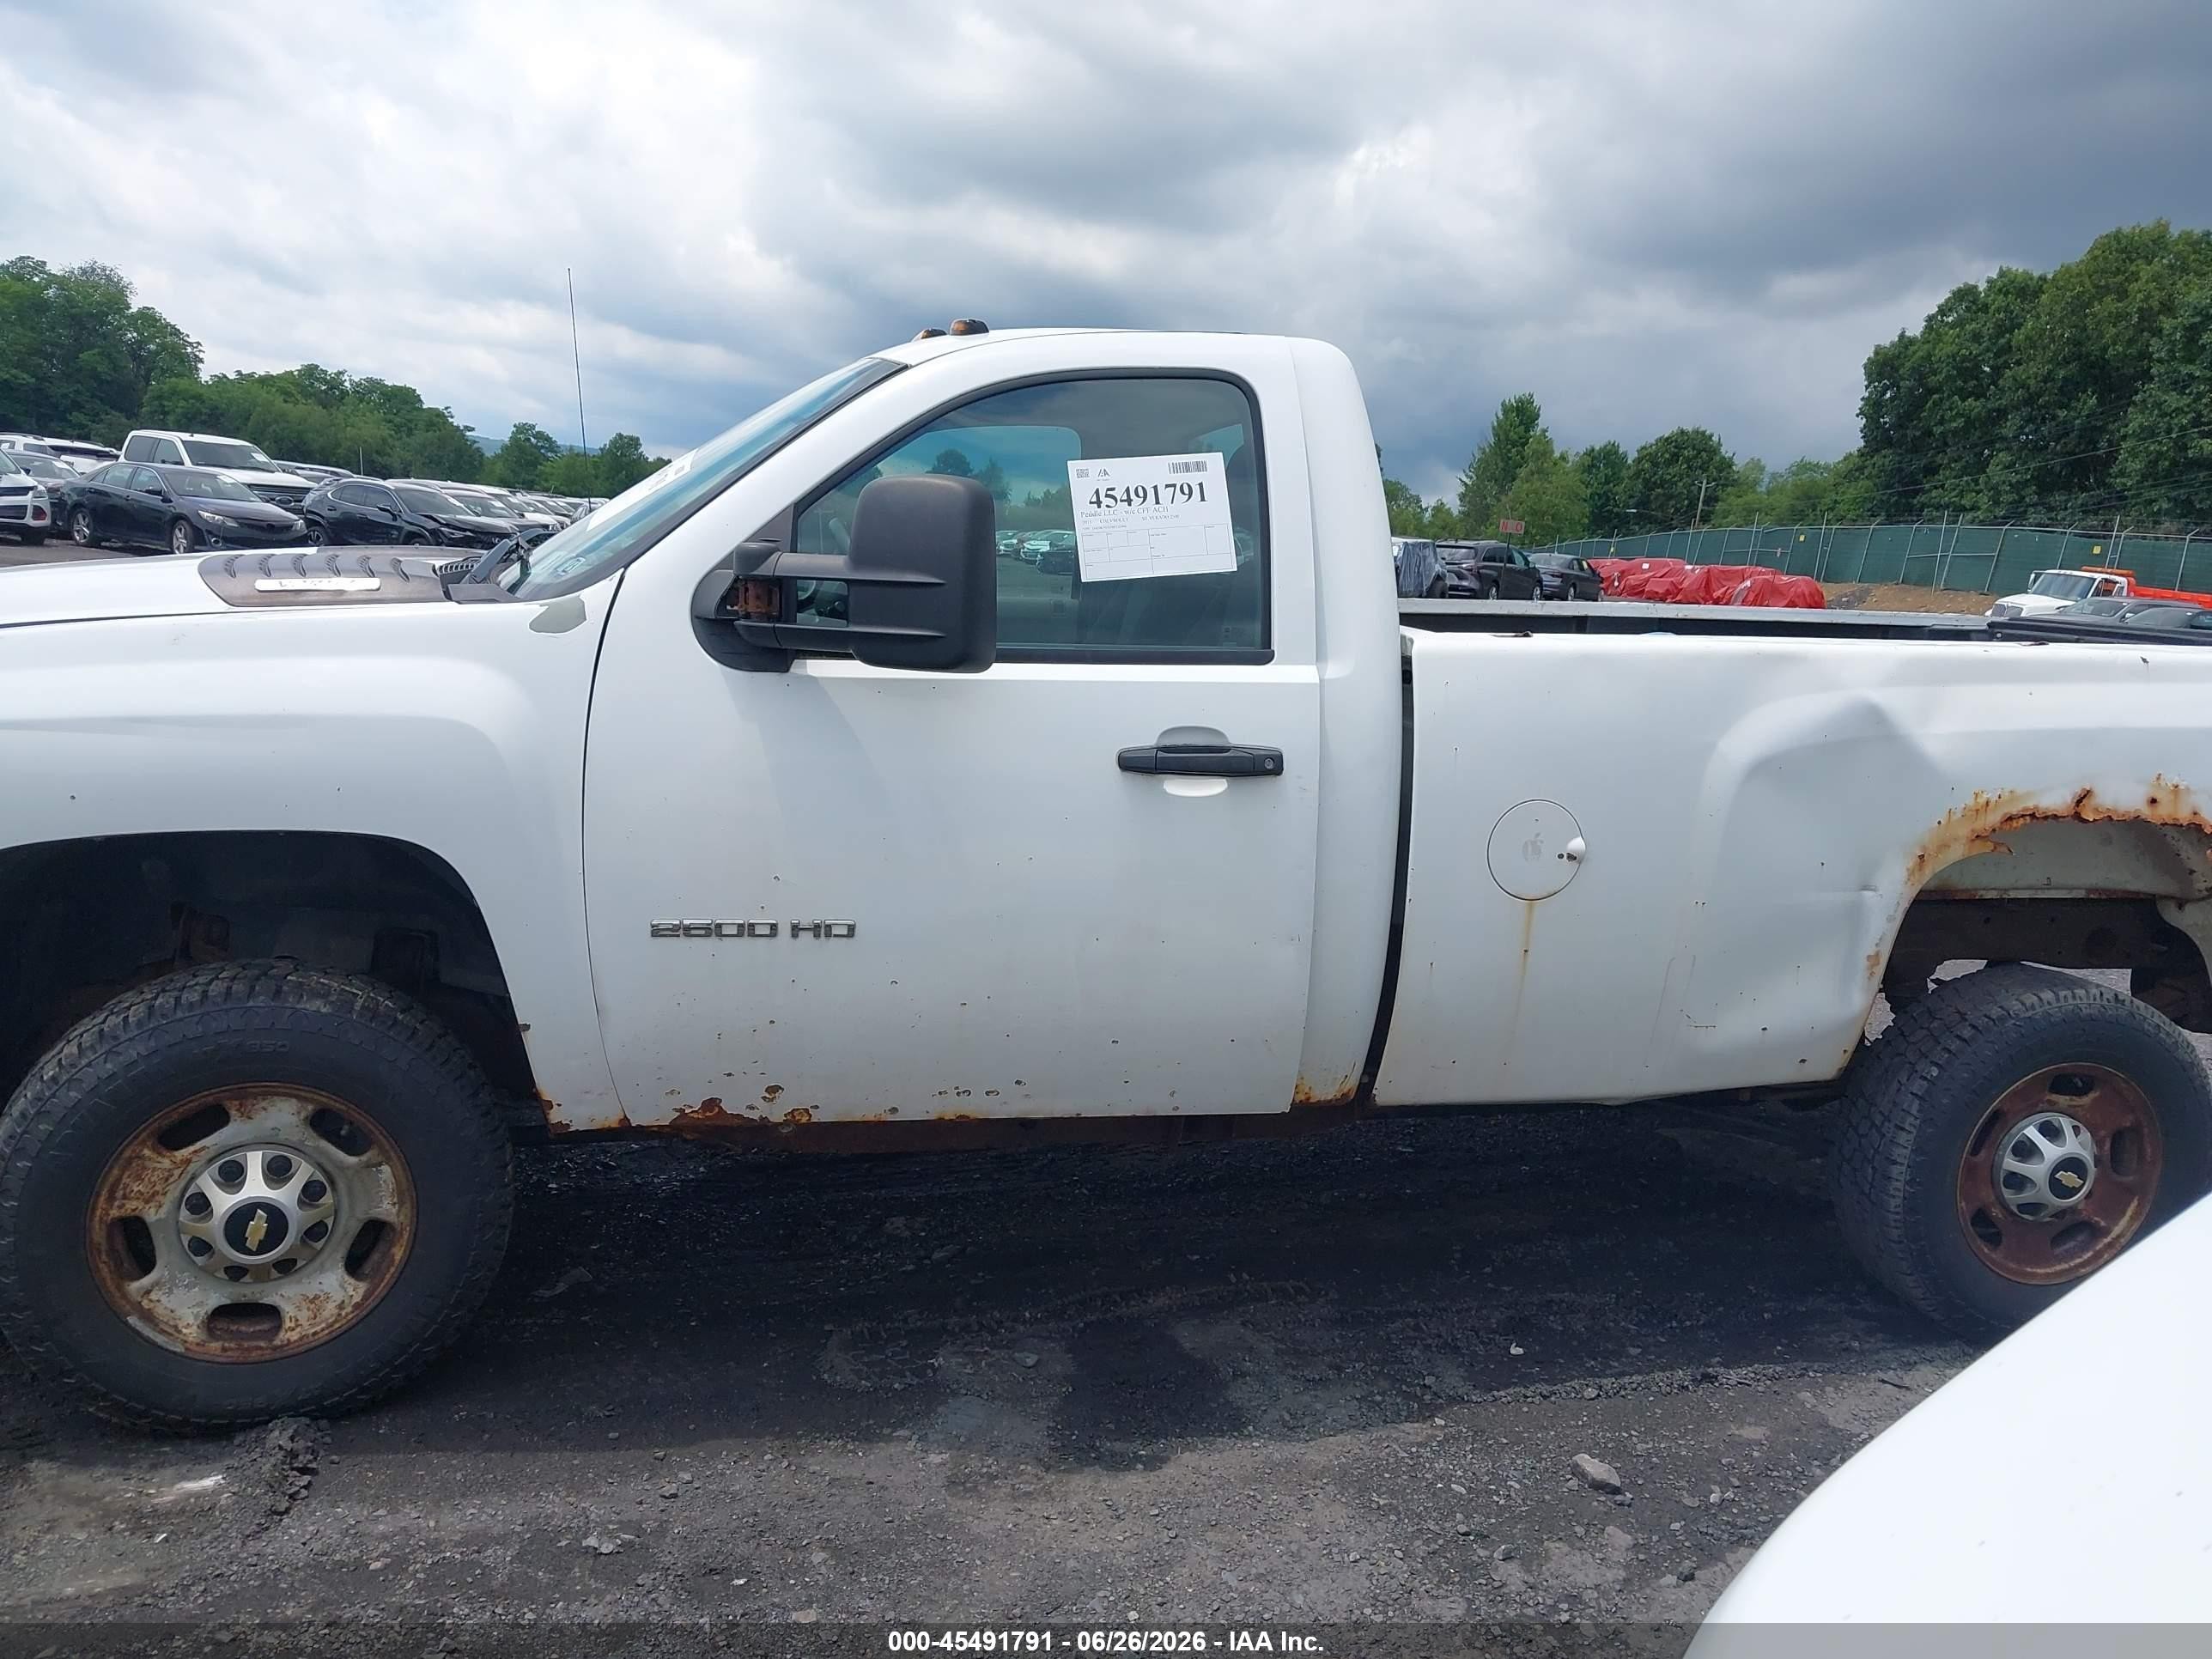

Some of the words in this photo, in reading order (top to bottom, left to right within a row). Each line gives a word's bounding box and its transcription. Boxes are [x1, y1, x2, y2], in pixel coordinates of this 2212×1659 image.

[1089, 481, 1209, 509] 45491791
[1103, 508, 1118, 517] LLC
[650, 918, 778, 938] 2500
[790, 918, 856, 938] HD
